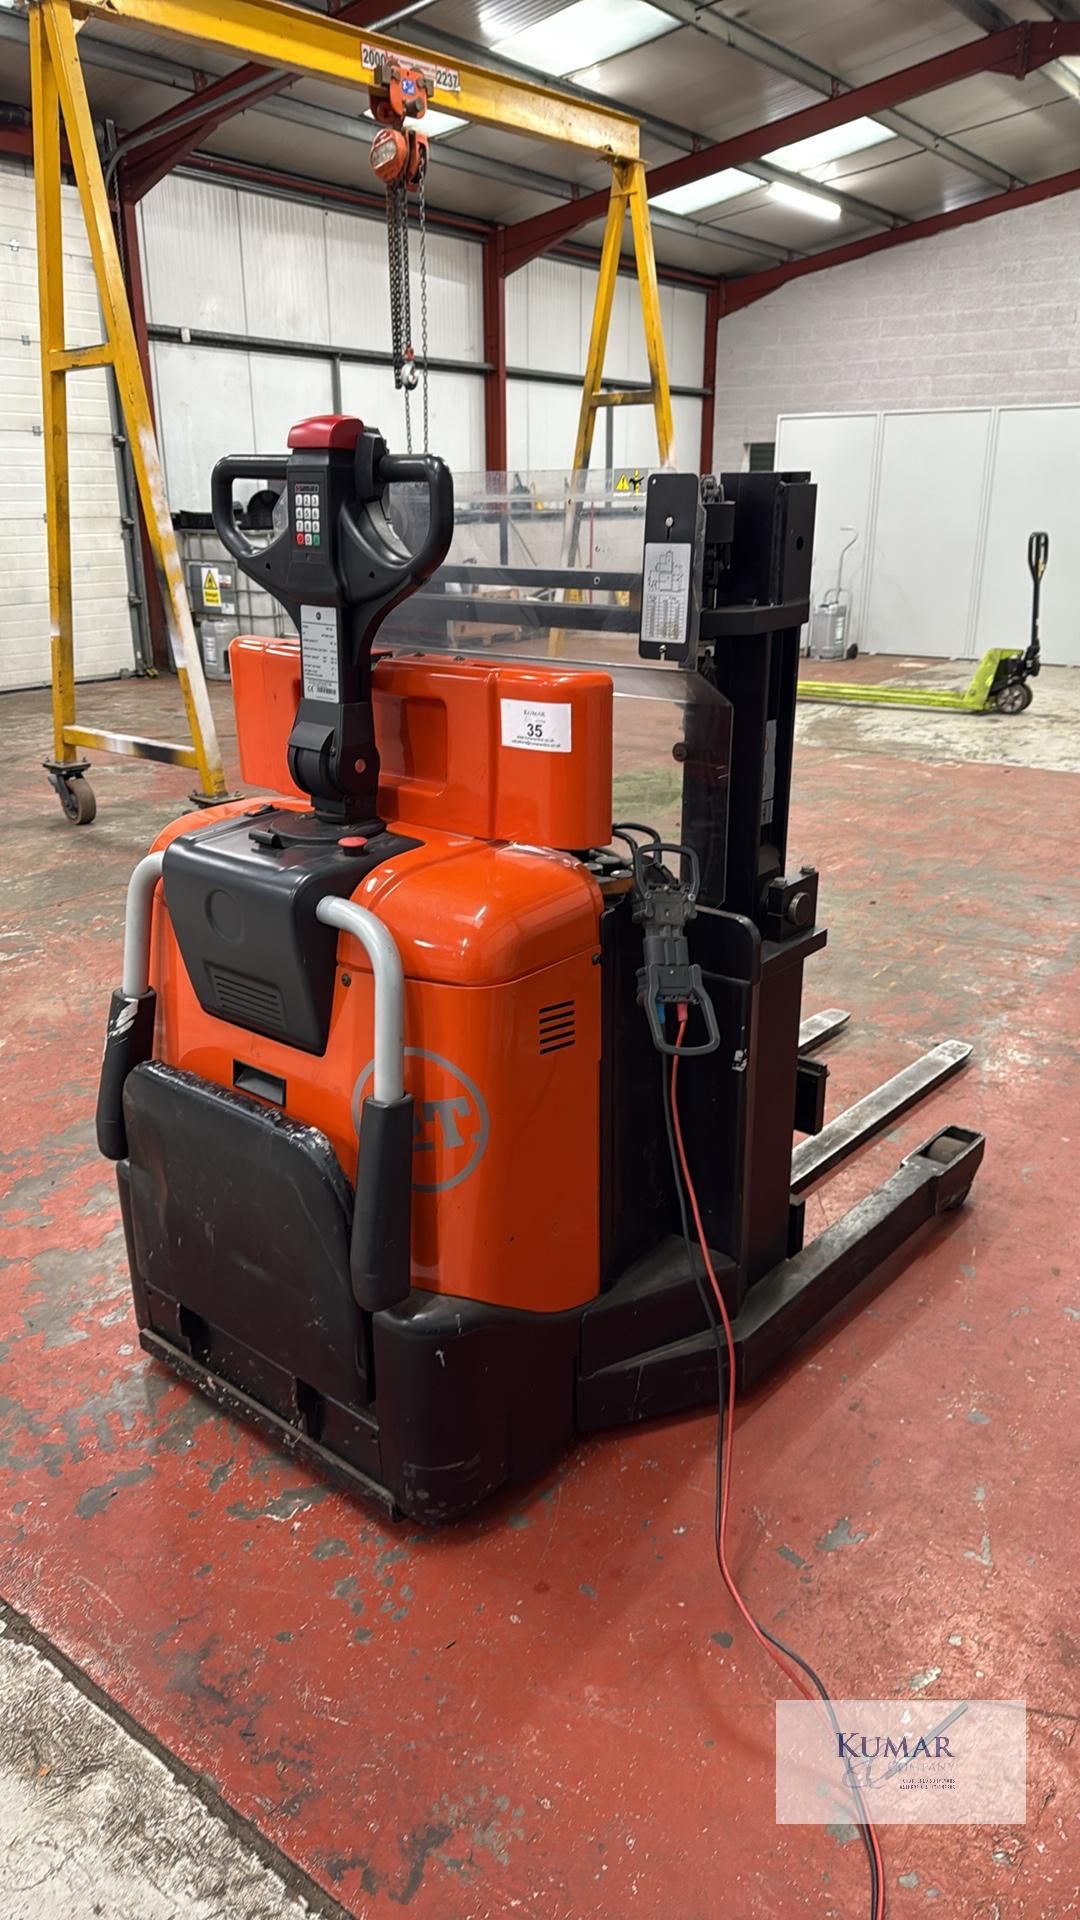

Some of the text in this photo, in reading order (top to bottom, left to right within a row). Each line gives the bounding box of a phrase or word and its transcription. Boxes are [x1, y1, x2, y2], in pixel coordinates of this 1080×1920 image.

[435, 70, 458, 88] 2237
[527, 723, 543, 737] 35
[412, 1096, 471, 1151] T
